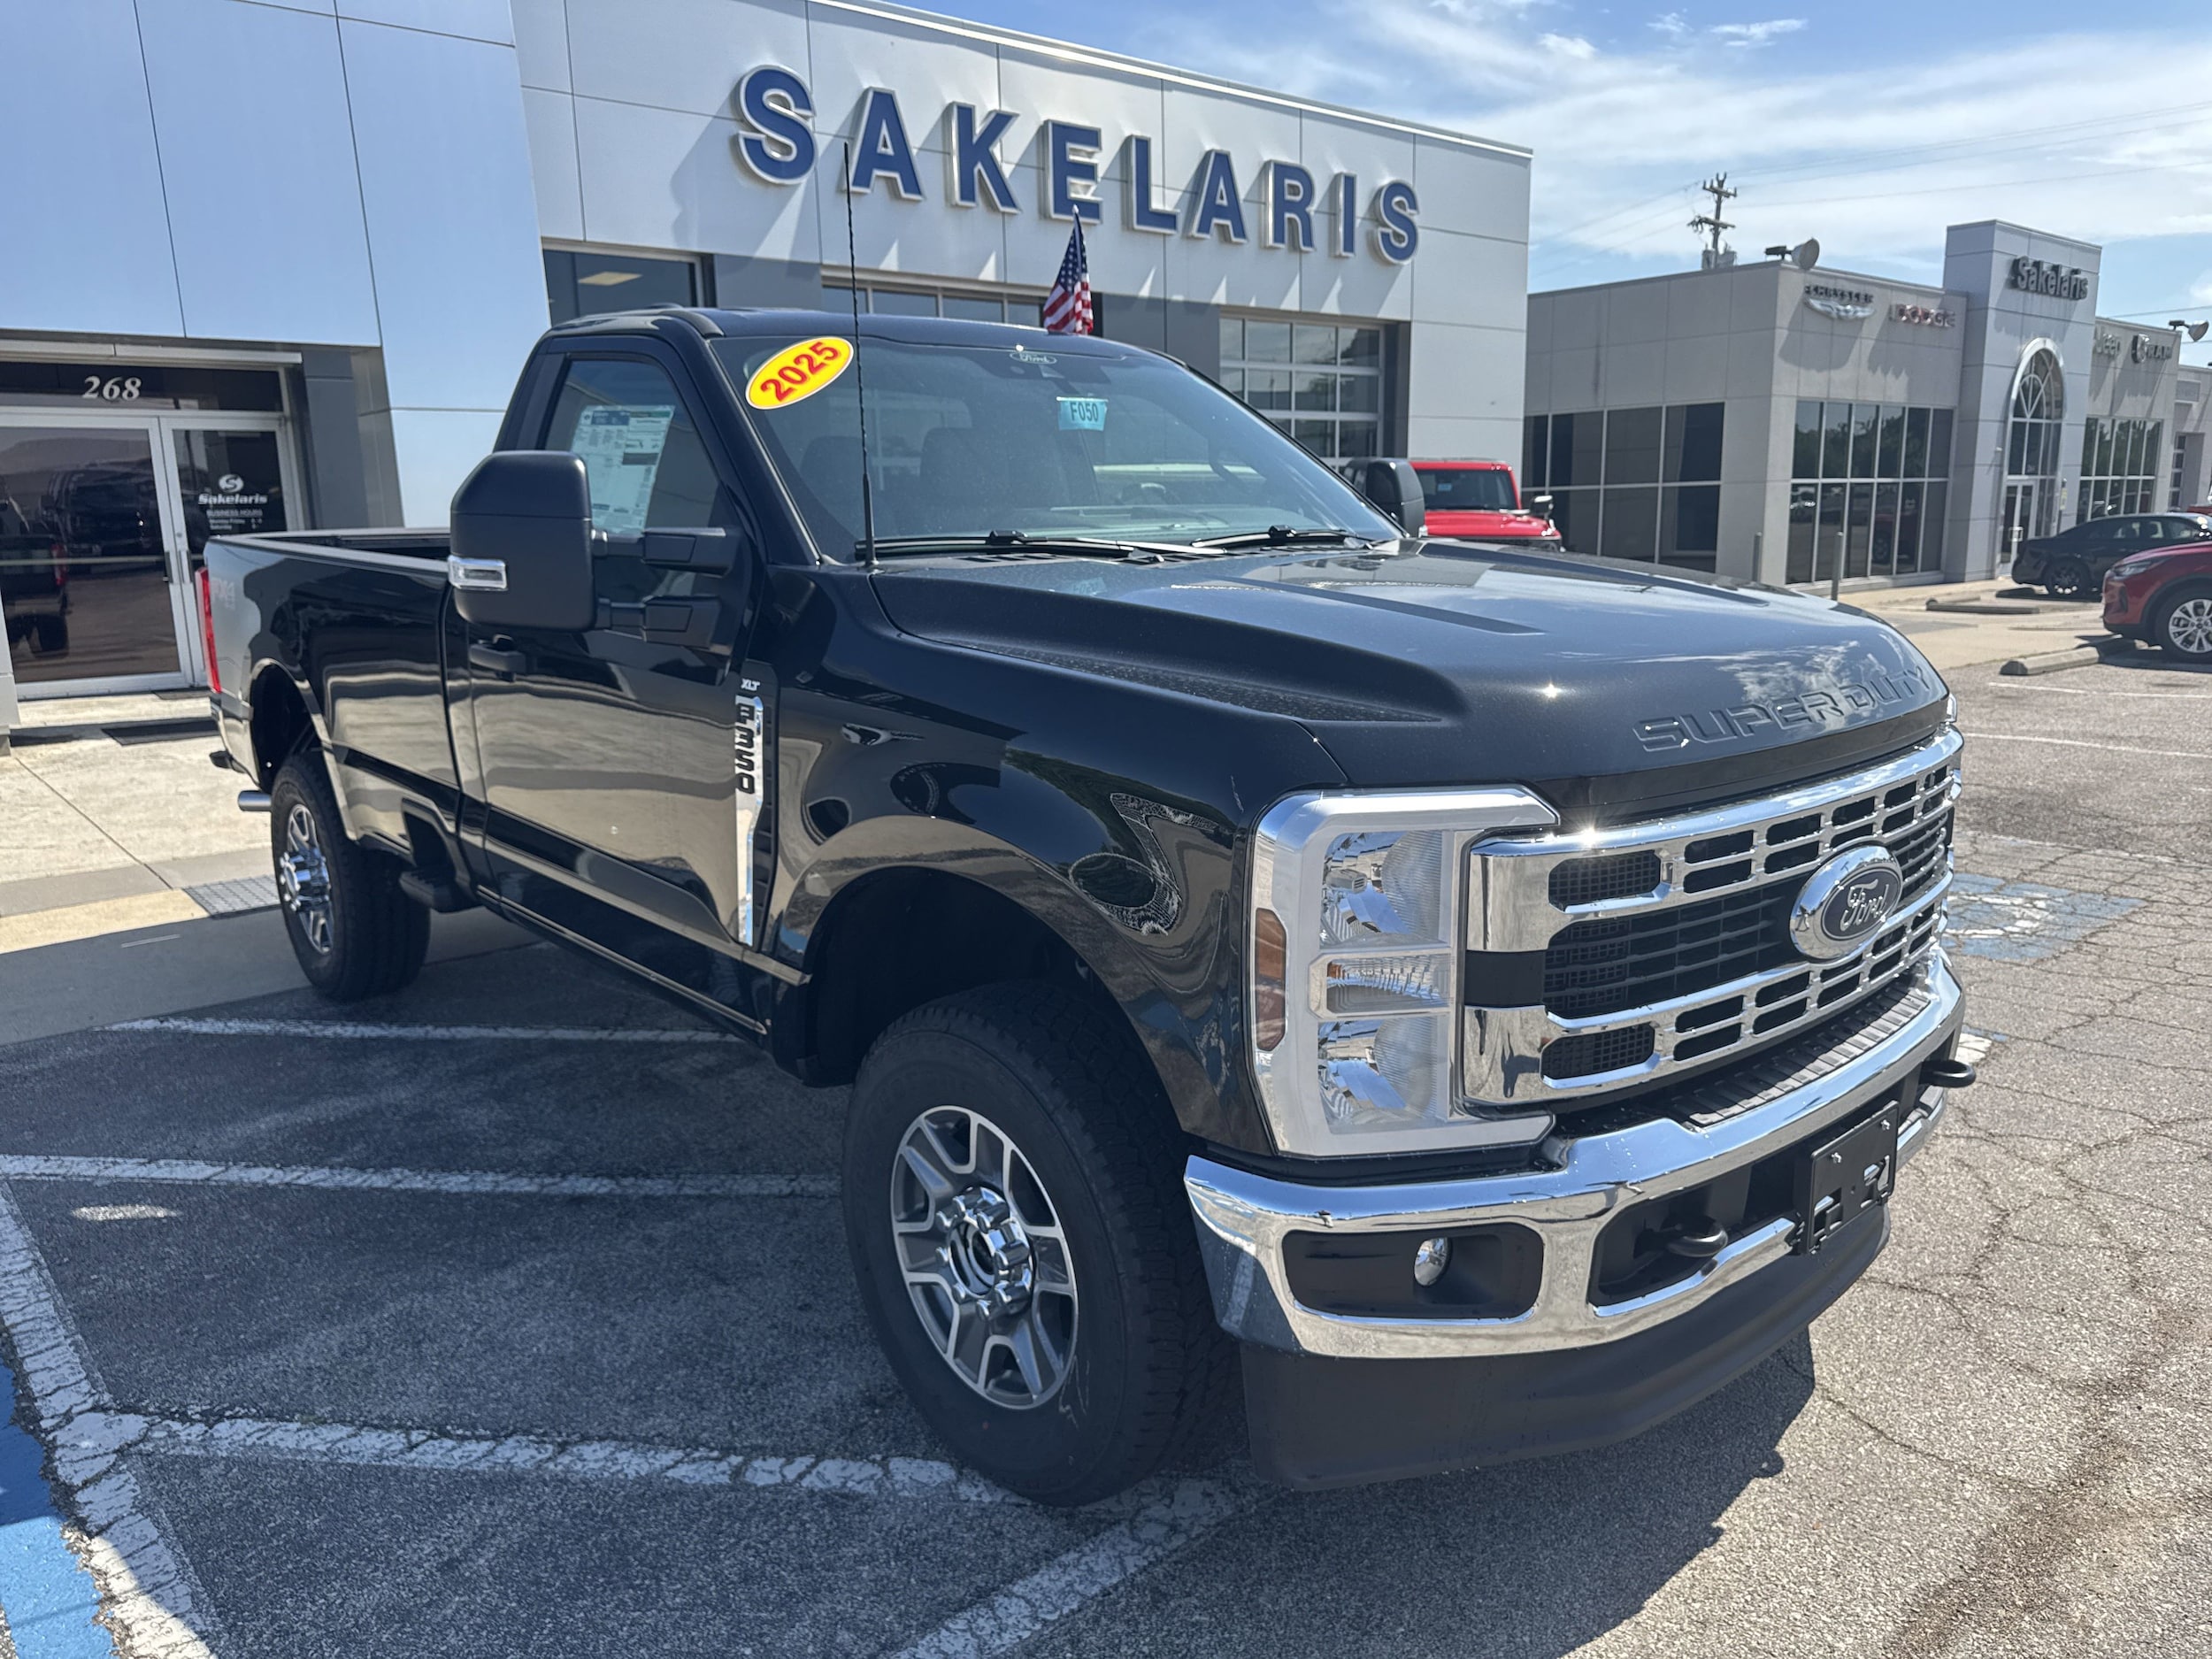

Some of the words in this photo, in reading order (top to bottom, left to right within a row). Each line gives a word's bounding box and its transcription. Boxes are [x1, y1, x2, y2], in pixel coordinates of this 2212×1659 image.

[735, 65, 1418, 265] SAKELARIS
[2013, 255, 2088, 301] Sakelaris
[1891, 303, 1955, 328] DODGE
[82, 375, 142, 401] 268
[759, 341, 840, 402] 2025
[1070, 401, 1100, 423] F050
[197, 493, 268, 505] Sakelaris
[741, 678, 760, 691] XLT
[1632, 691, 1844, 751] SUPER
[1839, 664, 1931, 711] DUTY
[1839, 878, 1890, 932] Ford
